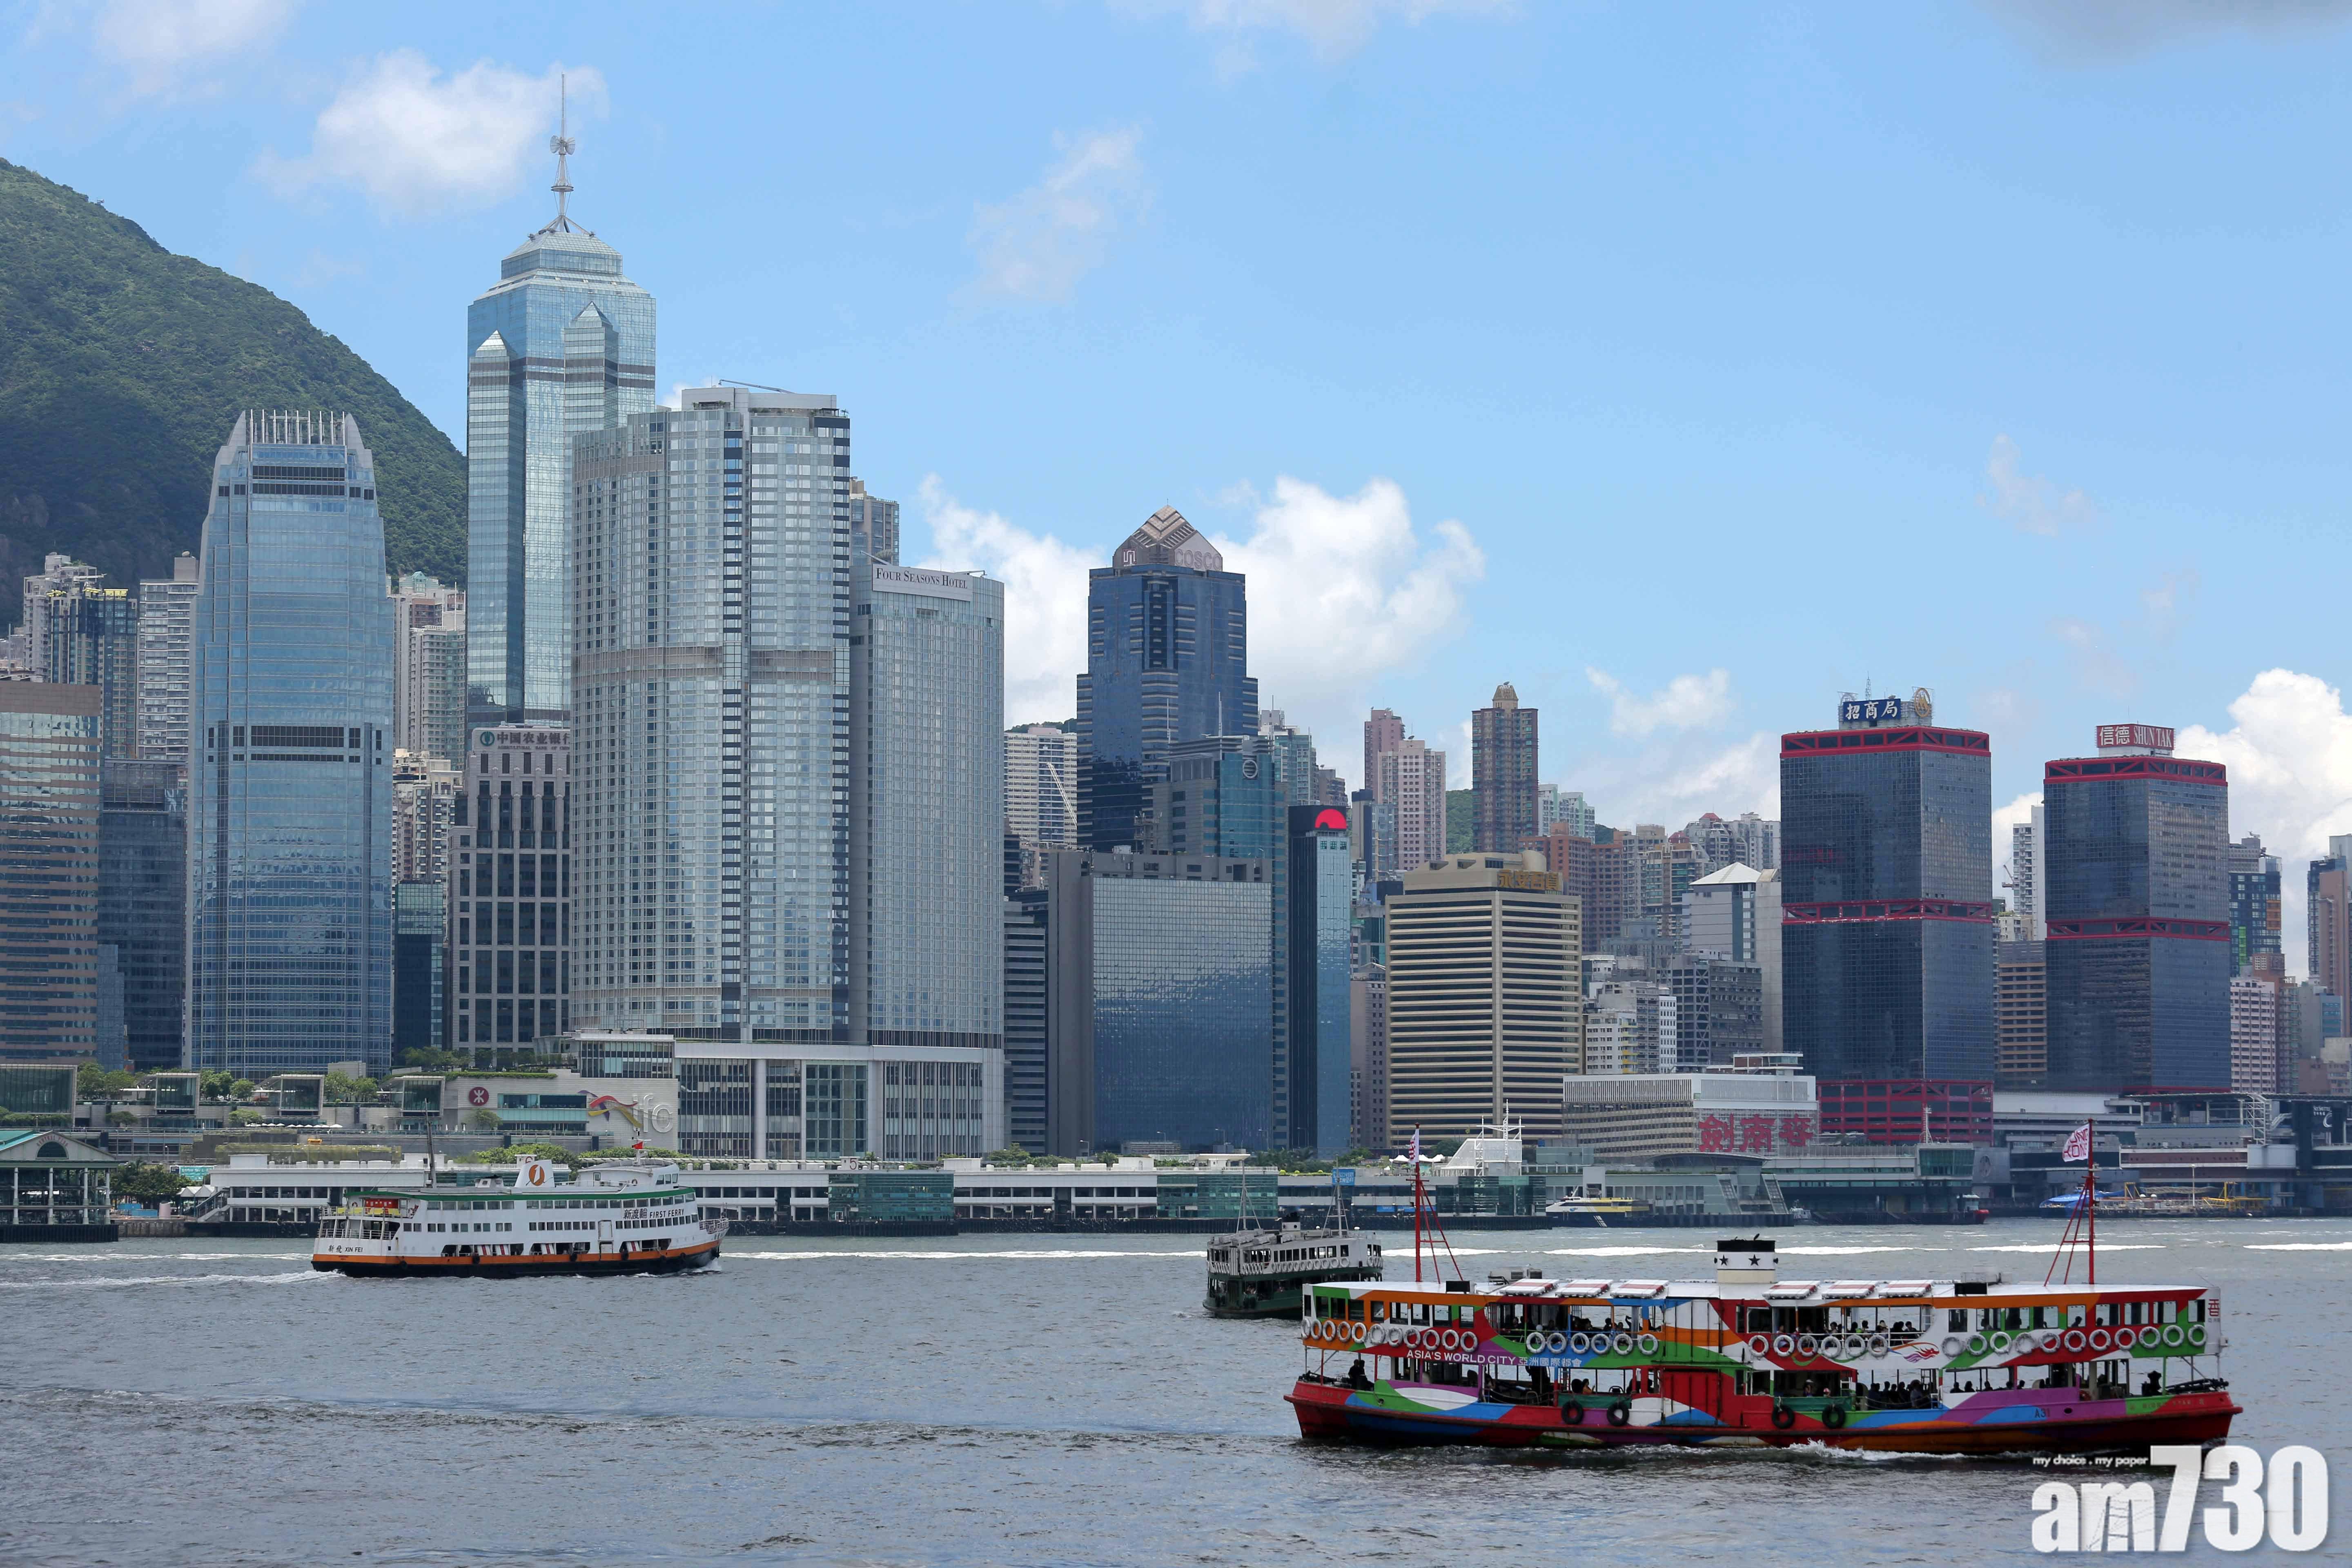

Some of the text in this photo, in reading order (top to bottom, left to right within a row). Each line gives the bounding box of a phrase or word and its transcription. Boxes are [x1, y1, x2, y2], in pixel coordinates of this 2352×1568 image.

[1175, 549, 1222, 570] COSCO
[876, 568, 967, 589] FOUR SEASONS HOTEL
[1845, 701, 1898, 720] 招商局
[2100, 726, 2130, 745] 信德
[2134, 725, 2172, 748] SHUN TAK
[1497, 869, 1559, 890] 永安百貨
[633, 1094, 673, 1133] ifc
[850, 1158, 857, 1170] 5
[624, 1208, 647, 1219] 新渡輪
[668, 1209, 684, 1217] FERRY
[1407, 1350, 1516, 1365] ASIA'S WORLD CITY
[1518, 1356, 1582, 1367] 亞洲國際都會
